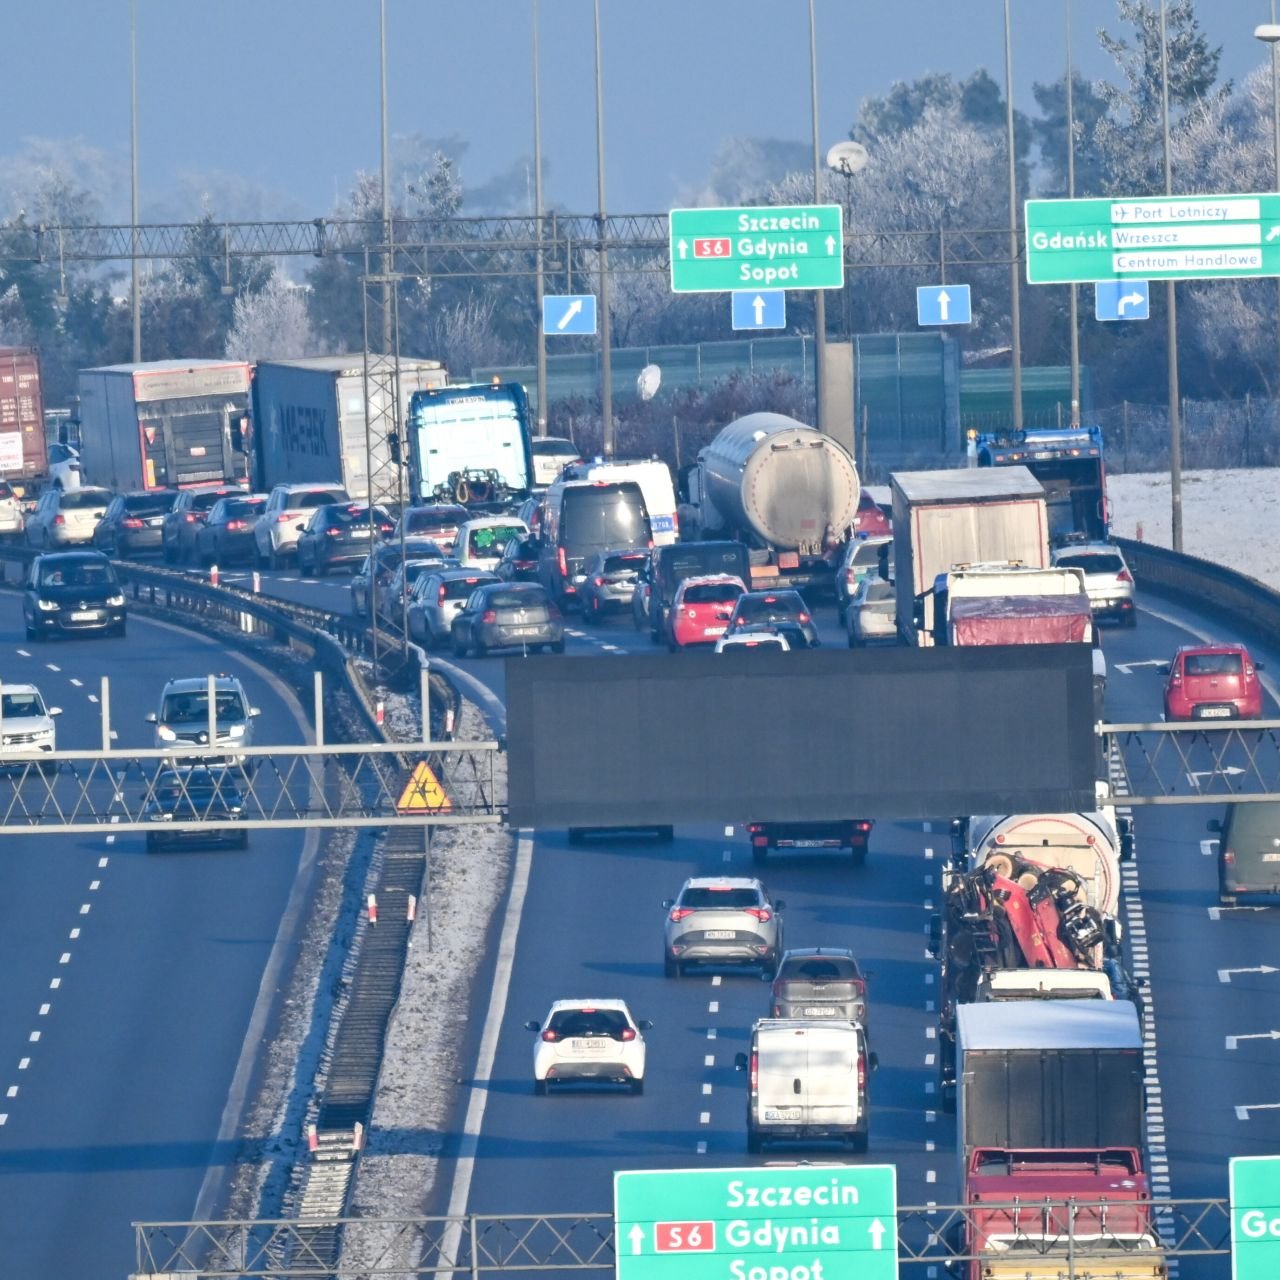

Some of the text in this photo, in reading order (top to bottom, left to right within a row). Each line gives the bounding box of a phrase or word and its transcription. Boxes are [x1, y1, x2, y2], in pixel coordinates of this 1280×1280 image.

[738, 212, 820, 232] Szczecin
[1134, 204, 1228, 220] Port Lotniczy
[1032, 229, 1108, 250] Gdańsk
[1116, 231, 1178, 244] Wrzeszcz
[737, 237, 808, 260] Gdynia
[1116, 253, 1257, 269] Centrum Handlowe
[740, 263, 798, 285] Sopot
[726, 1177, 858, 1207] Szczecin
[724, 1217, 840, 1253] Gdynia
